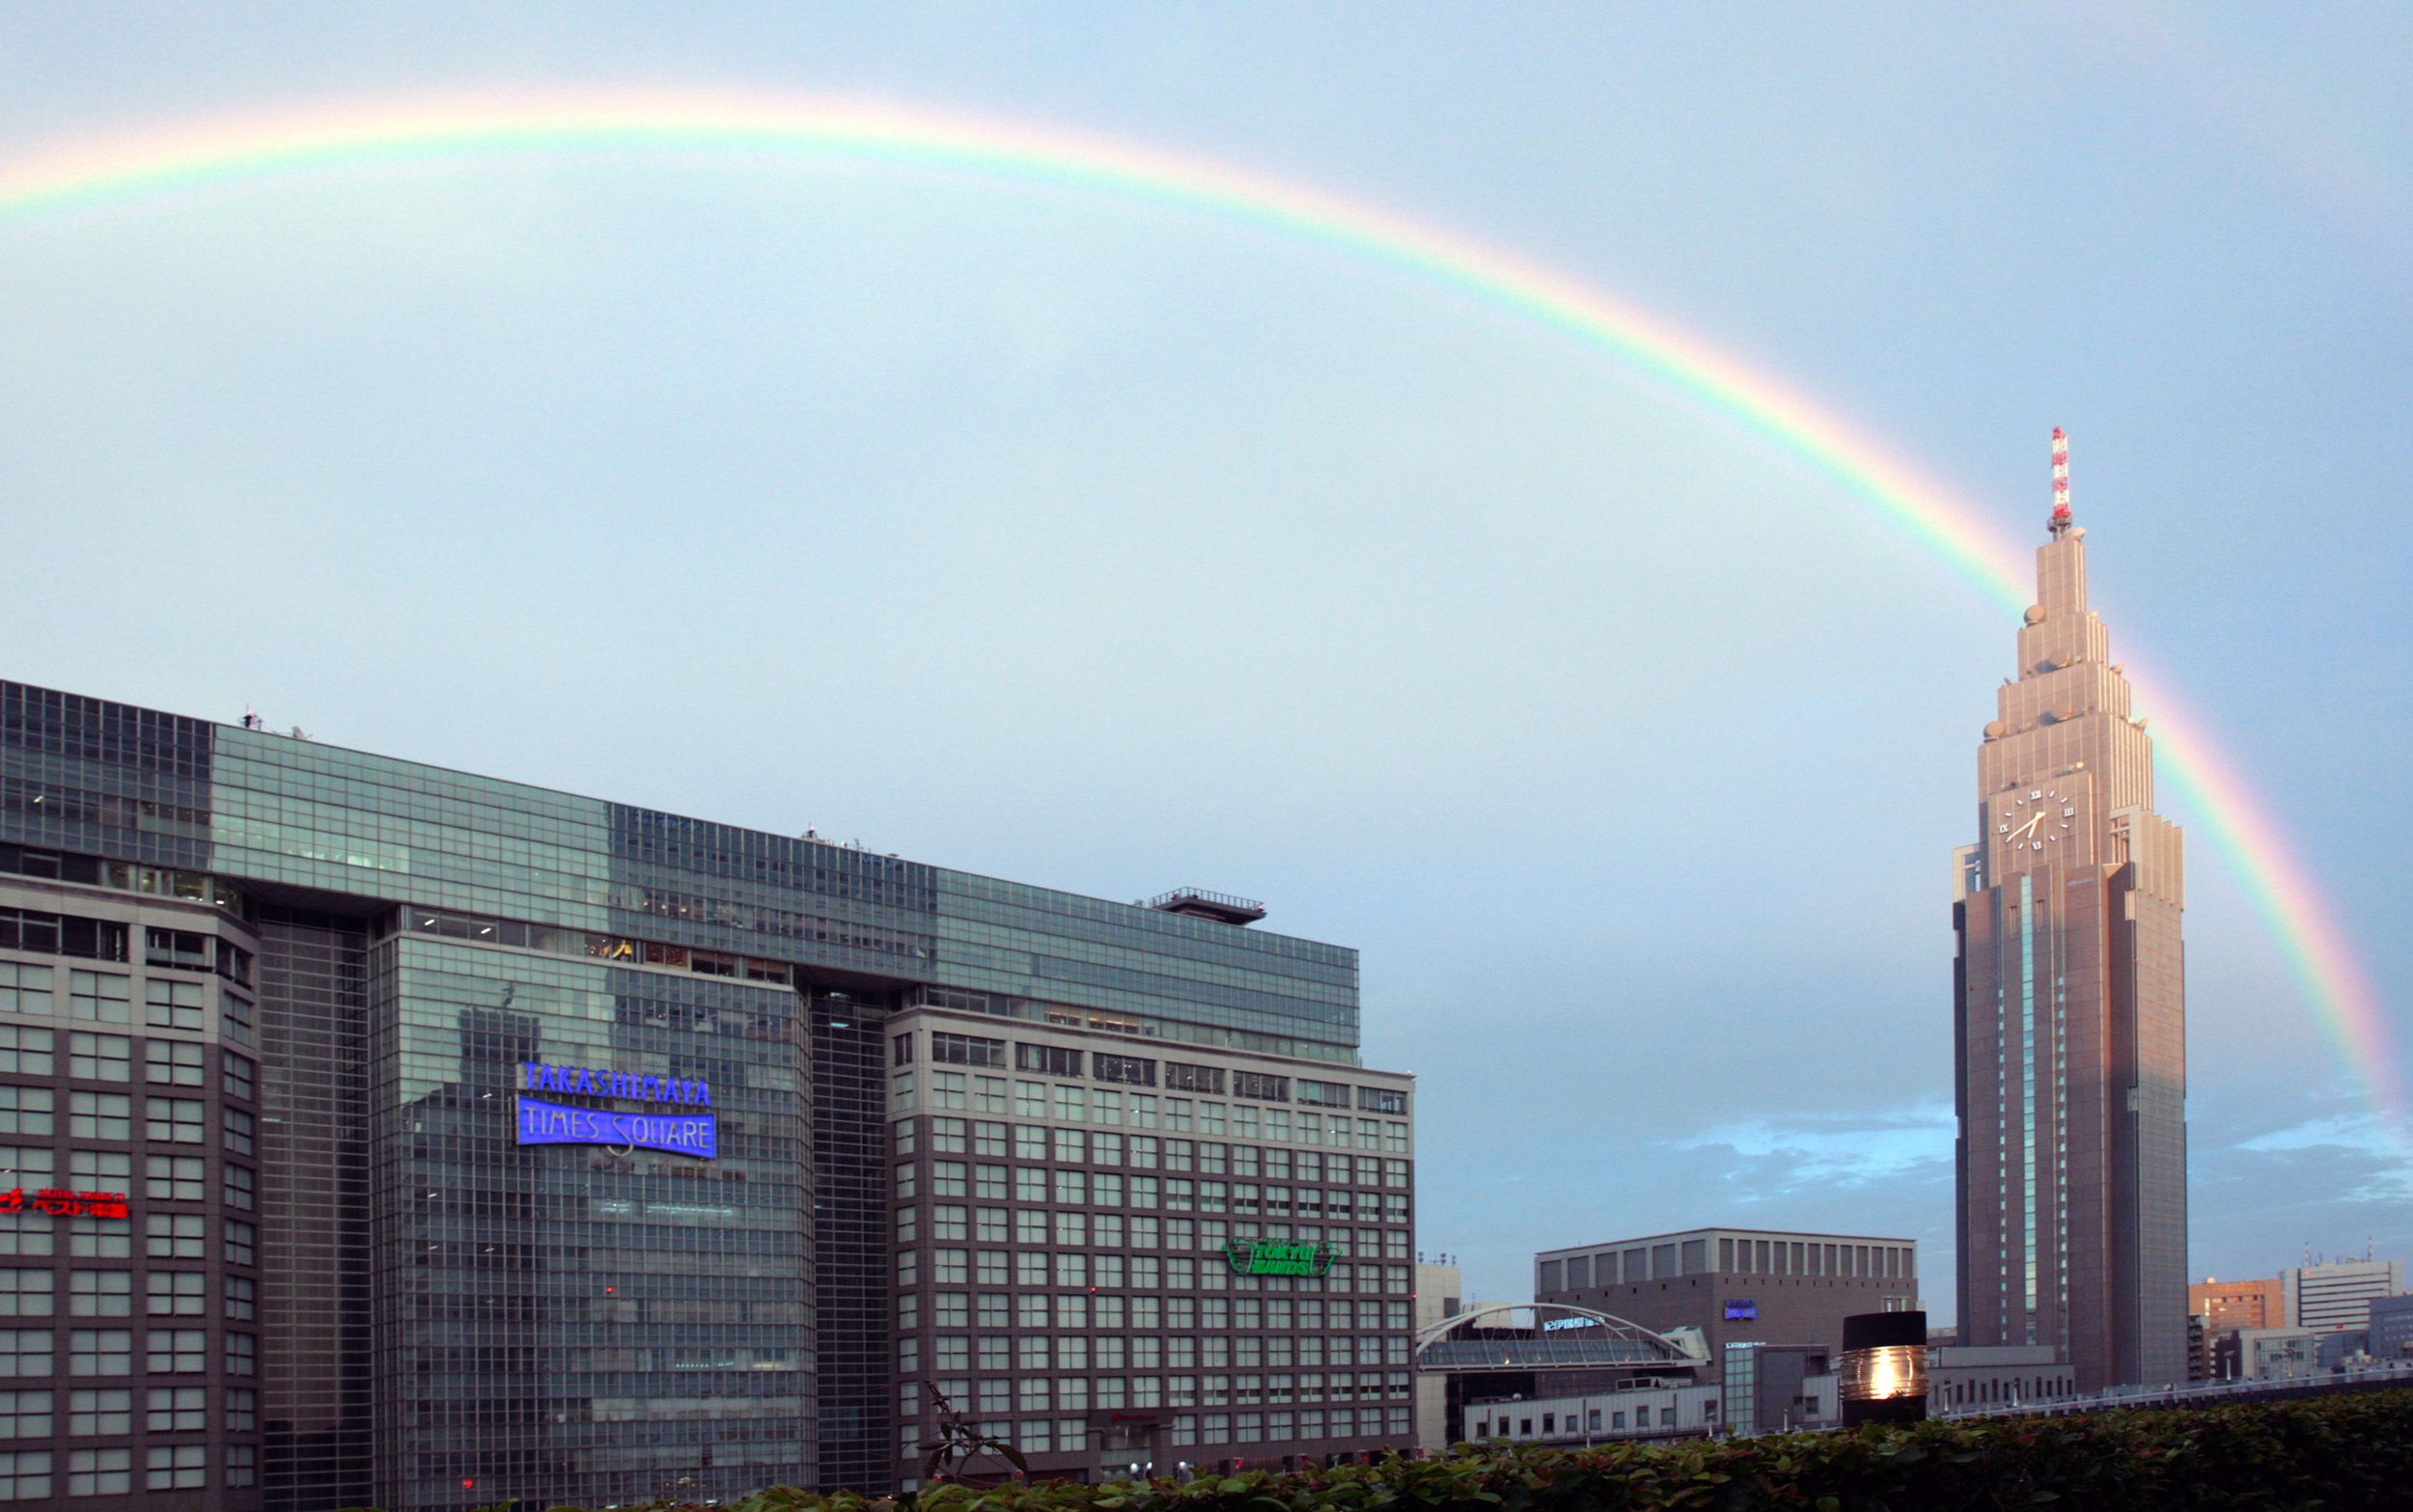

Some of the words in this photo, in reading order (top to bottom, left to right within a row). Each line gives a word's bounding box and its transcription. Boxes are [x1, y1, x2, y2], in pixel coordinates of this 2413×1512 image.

[522, 1061, 711, 1108] TAKASHIMAYA
[525, 1107, 599, 1140] TIMES
[606, 1114, 710, 1157] SQUARE
[1256, 1245, 1313, 1260] TOKYU
